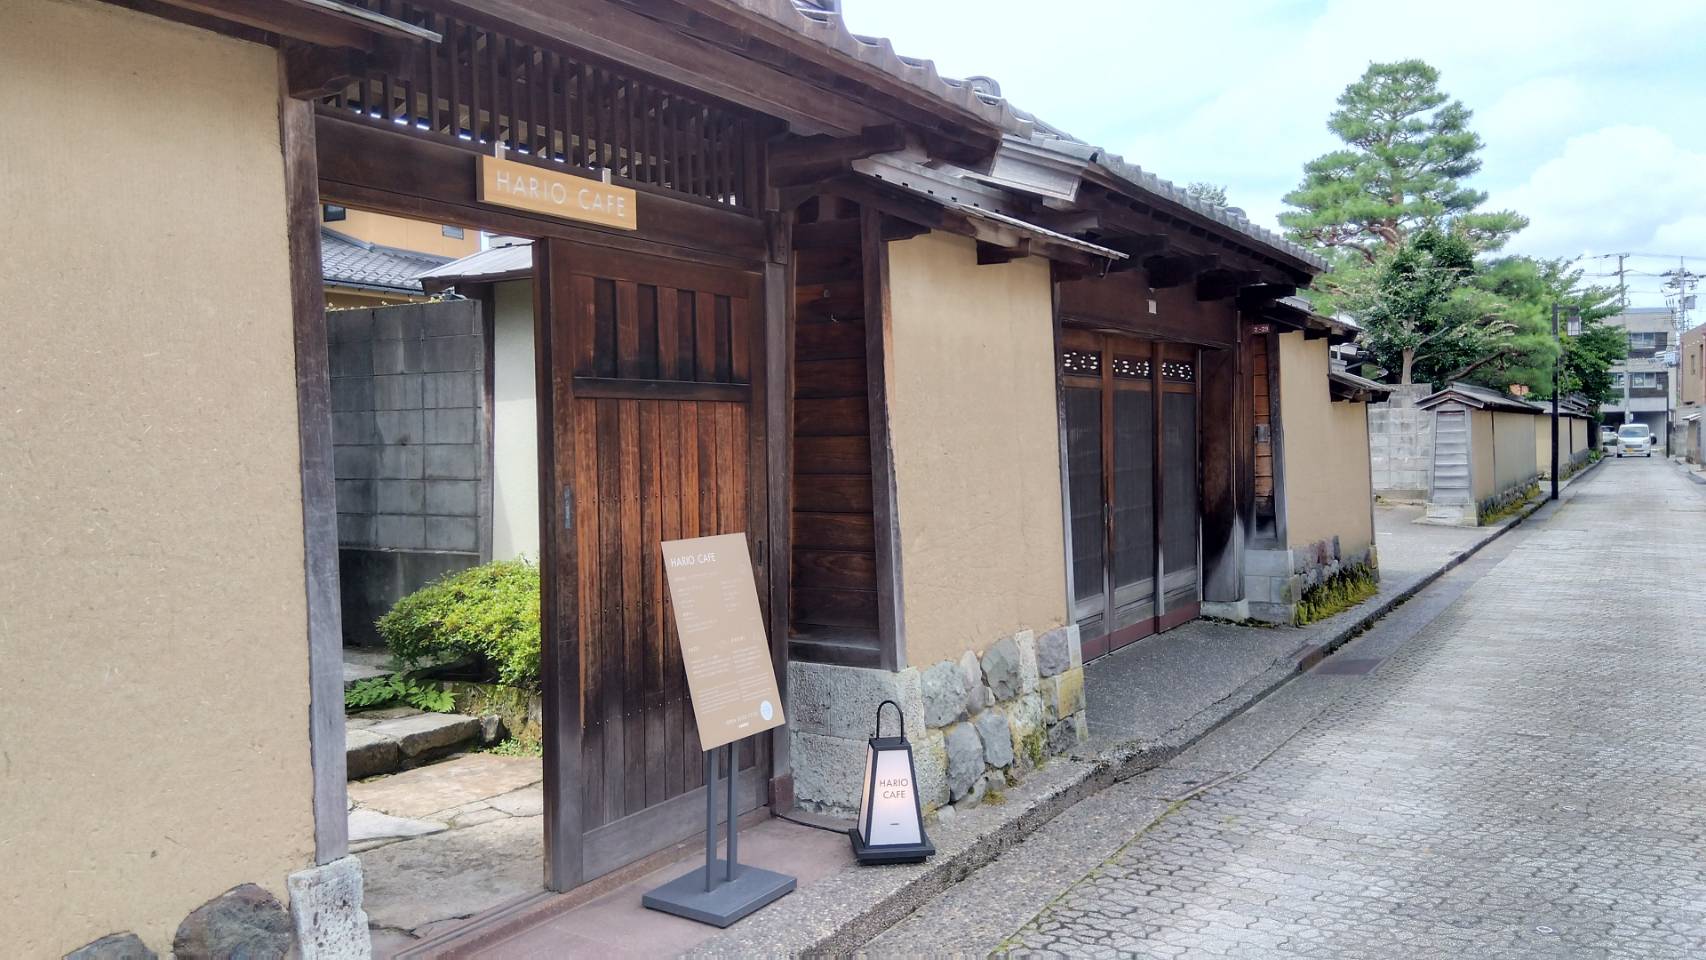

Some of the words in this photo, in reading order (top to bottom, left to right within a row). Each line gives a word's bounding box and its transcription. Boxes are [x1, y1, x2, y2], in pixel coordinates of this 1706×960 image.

[497, 170, 566, 204] HARIO
[578, 189, 625, 217] CAFE
[670, 554, 695, 567] HARIO
[697, 552, 717, 565] CAFE
[879, 778, 908, 787] HARIO
[882, 790, 906, 798] CAFE
